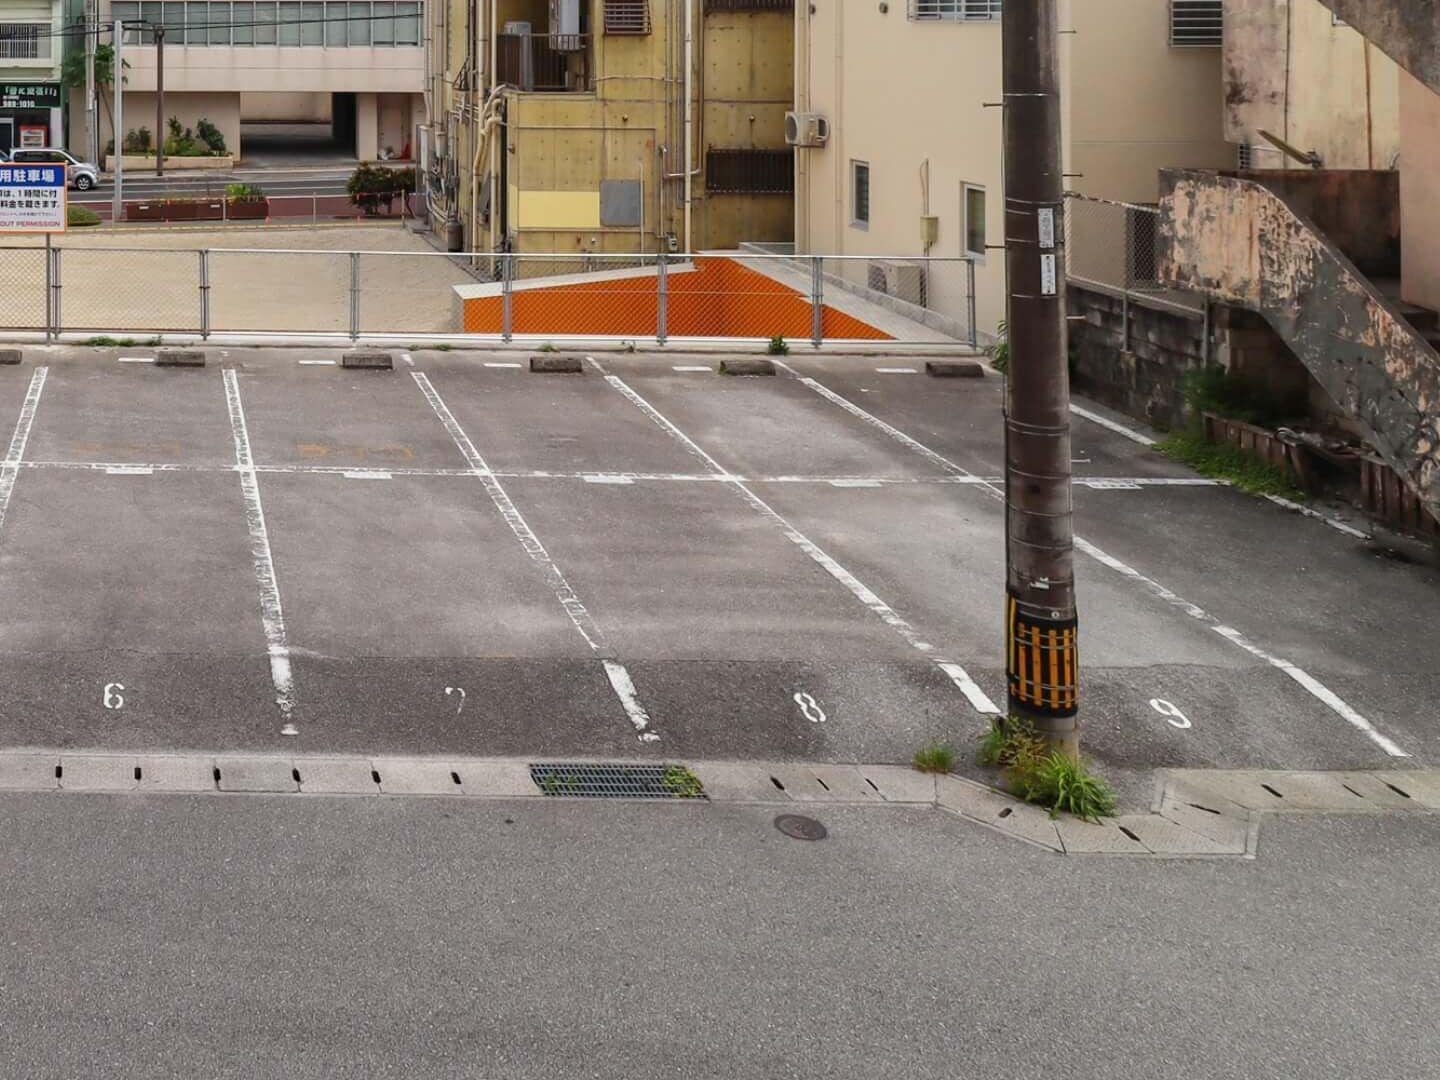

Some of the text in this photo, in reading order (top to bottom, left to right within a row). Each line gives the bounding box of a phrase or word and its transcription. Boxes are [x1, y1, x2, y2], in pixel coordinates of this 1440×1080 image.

[103, 682, 125, 709] 6
[445, 687, 466, 714] 7
[793, 692, 827, 723] 8
[1149, 698, 1192, 729] 9
